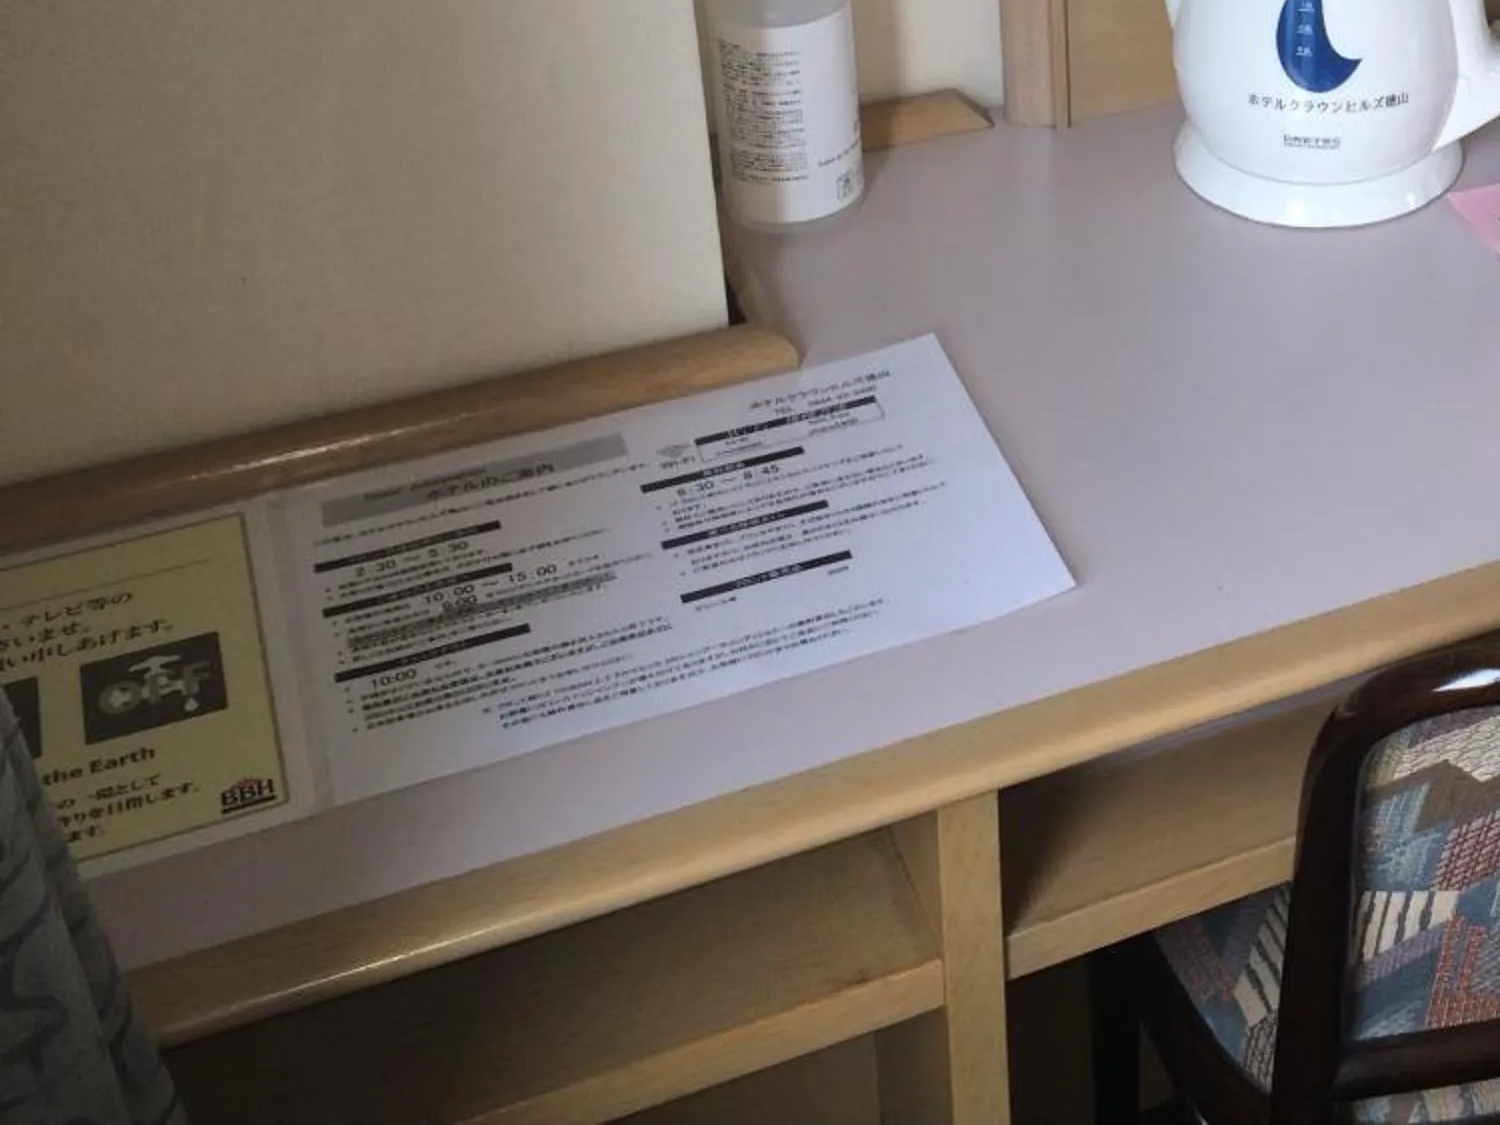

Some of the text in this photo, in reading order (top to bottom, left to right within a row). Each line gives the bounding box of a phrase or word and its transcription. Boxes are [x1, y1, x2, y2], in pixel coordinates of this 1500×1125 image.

[41, 747, 156, 786] the Earth
[220, 778, 275, 808] BBH
